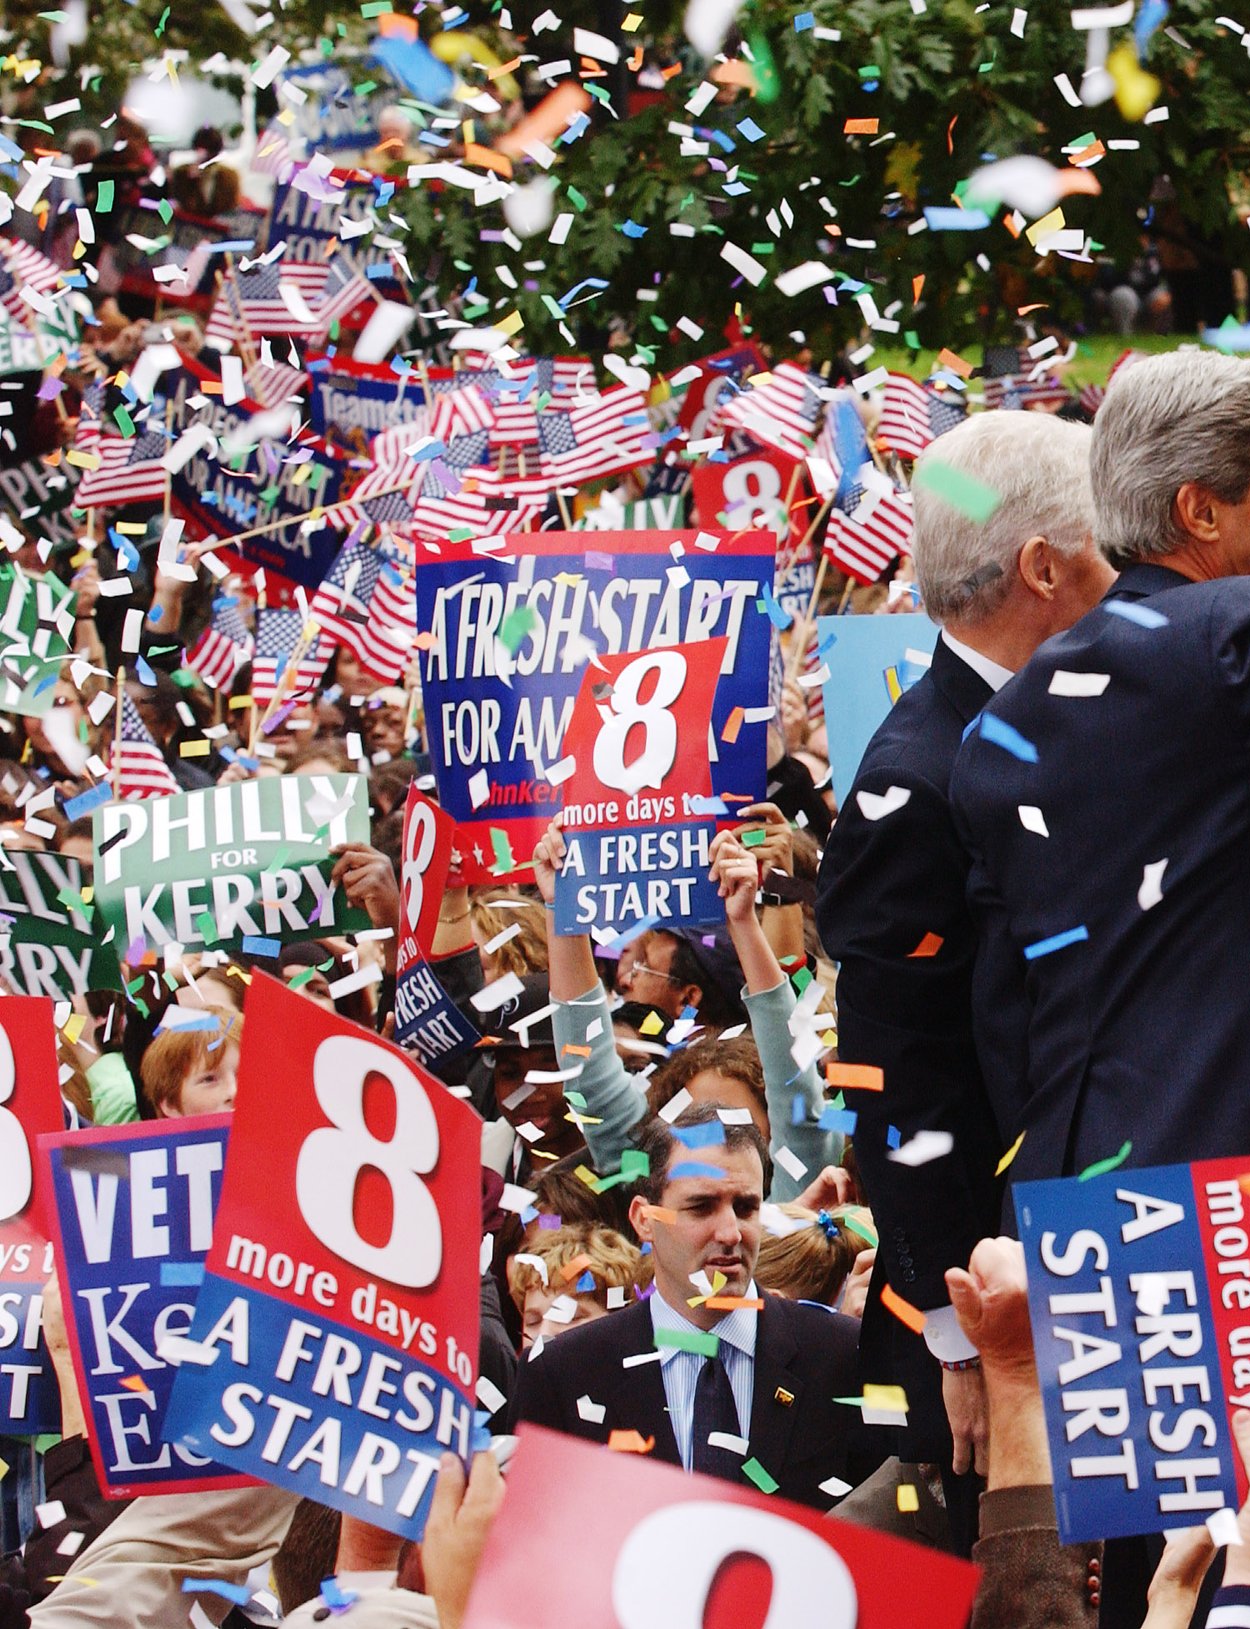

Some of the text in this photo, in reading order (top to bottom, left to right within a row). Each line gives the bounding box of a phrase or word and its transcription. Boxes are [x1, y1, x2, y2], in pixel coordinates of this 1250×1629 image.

[722, 460, 788, 543] 8
[427, 587, 448, 682] A
[441, 699, 502, 767] FOR
[592, 649, 688, 793] 8
[102, 775, 358, 886] PHILLY
[561, 828, 710, 878] A FRESH
[563, 800, 619, 827] more
[626, 794, 675, 824] days
[124, 863, 337, 948] KERRY
[210, 848, 258, 870] FOR
[575, 877, 697, 924] START
[295, 1034, 442, 1289] 8
[76, 1281, 198, 1376] Ke
[225, 1233, 473, 1387] more days to
[1115, 1188, 1226, 1513] A FRESH
[200, 1296, 471, 1460] A FRESH
[1040, 1228, 1140, 1491] START
[94, 1388, 215, 1473] E
[208, 1382, 442, 1518] START
